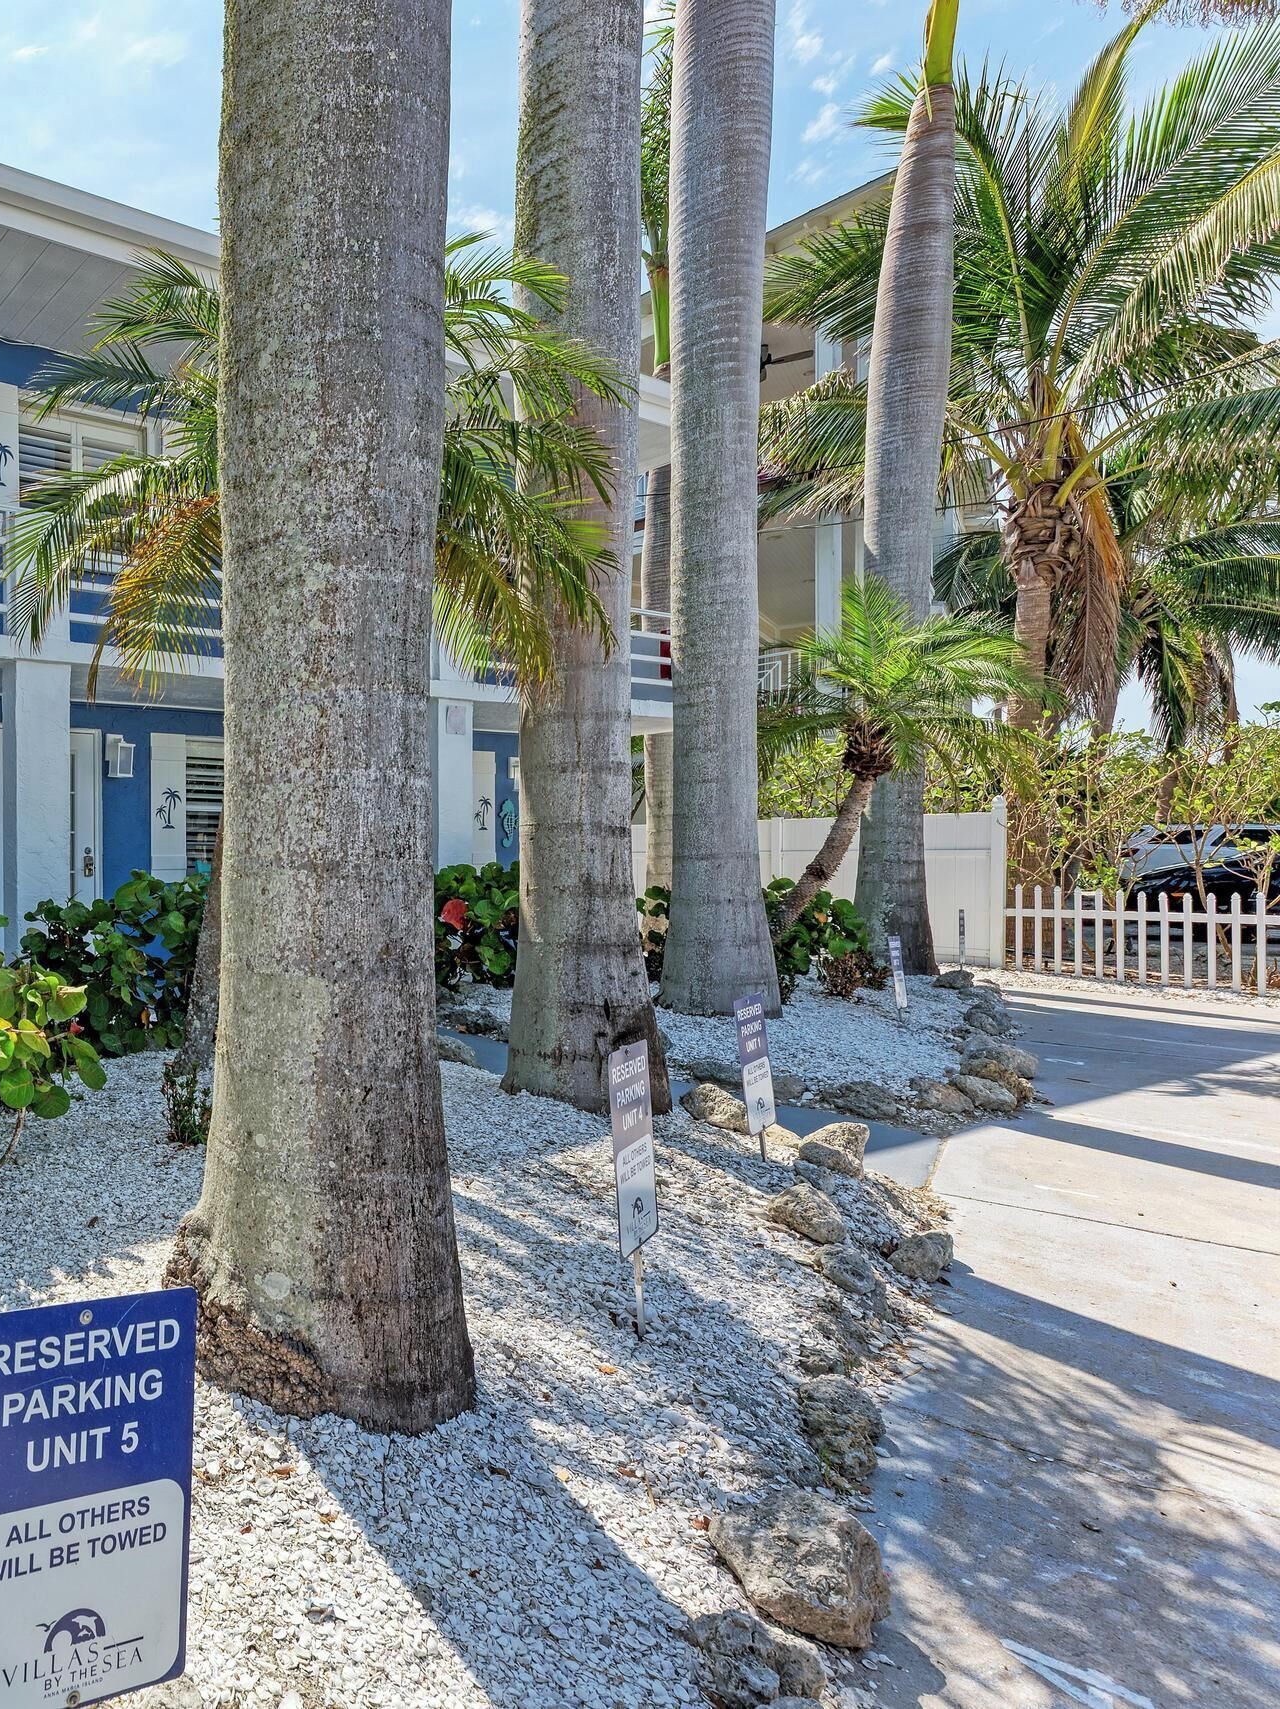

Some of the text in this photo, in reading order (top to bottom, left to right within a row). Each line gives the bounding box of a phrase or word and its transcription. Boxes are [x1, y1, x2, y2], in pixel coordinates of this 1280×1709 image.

[736, 1003, 762, 1021] RESERVED
[741, 1019, 762, 1038] PARKING
[745, 1038, 757, 1053] UNIT
[611, 1055, 646, 1085] RESERVED
[616, 1080, 646, 1109] PARKING
[622, 1105, 643, 1131] UNIT 4
[631, 1142, 647, 1160] OTHERS
[637, 1155, 651, 1172] TOWED
[1, 1368, 163, 1427] PARKING
[26, 1421, 139, 1473] UNIT 5
[5, 1495, 151, 1548] ALL OTHERS
[49, 1543, 80, 1569] BE
[86, 1521, 167, 1559] TOWED
[2, 1642, 99, 1688] VILLAS
[44, 1646, 143, 1691] BY THE SEA
[43, 1676, 104, 1699] ANNA MARIA ISLAND
